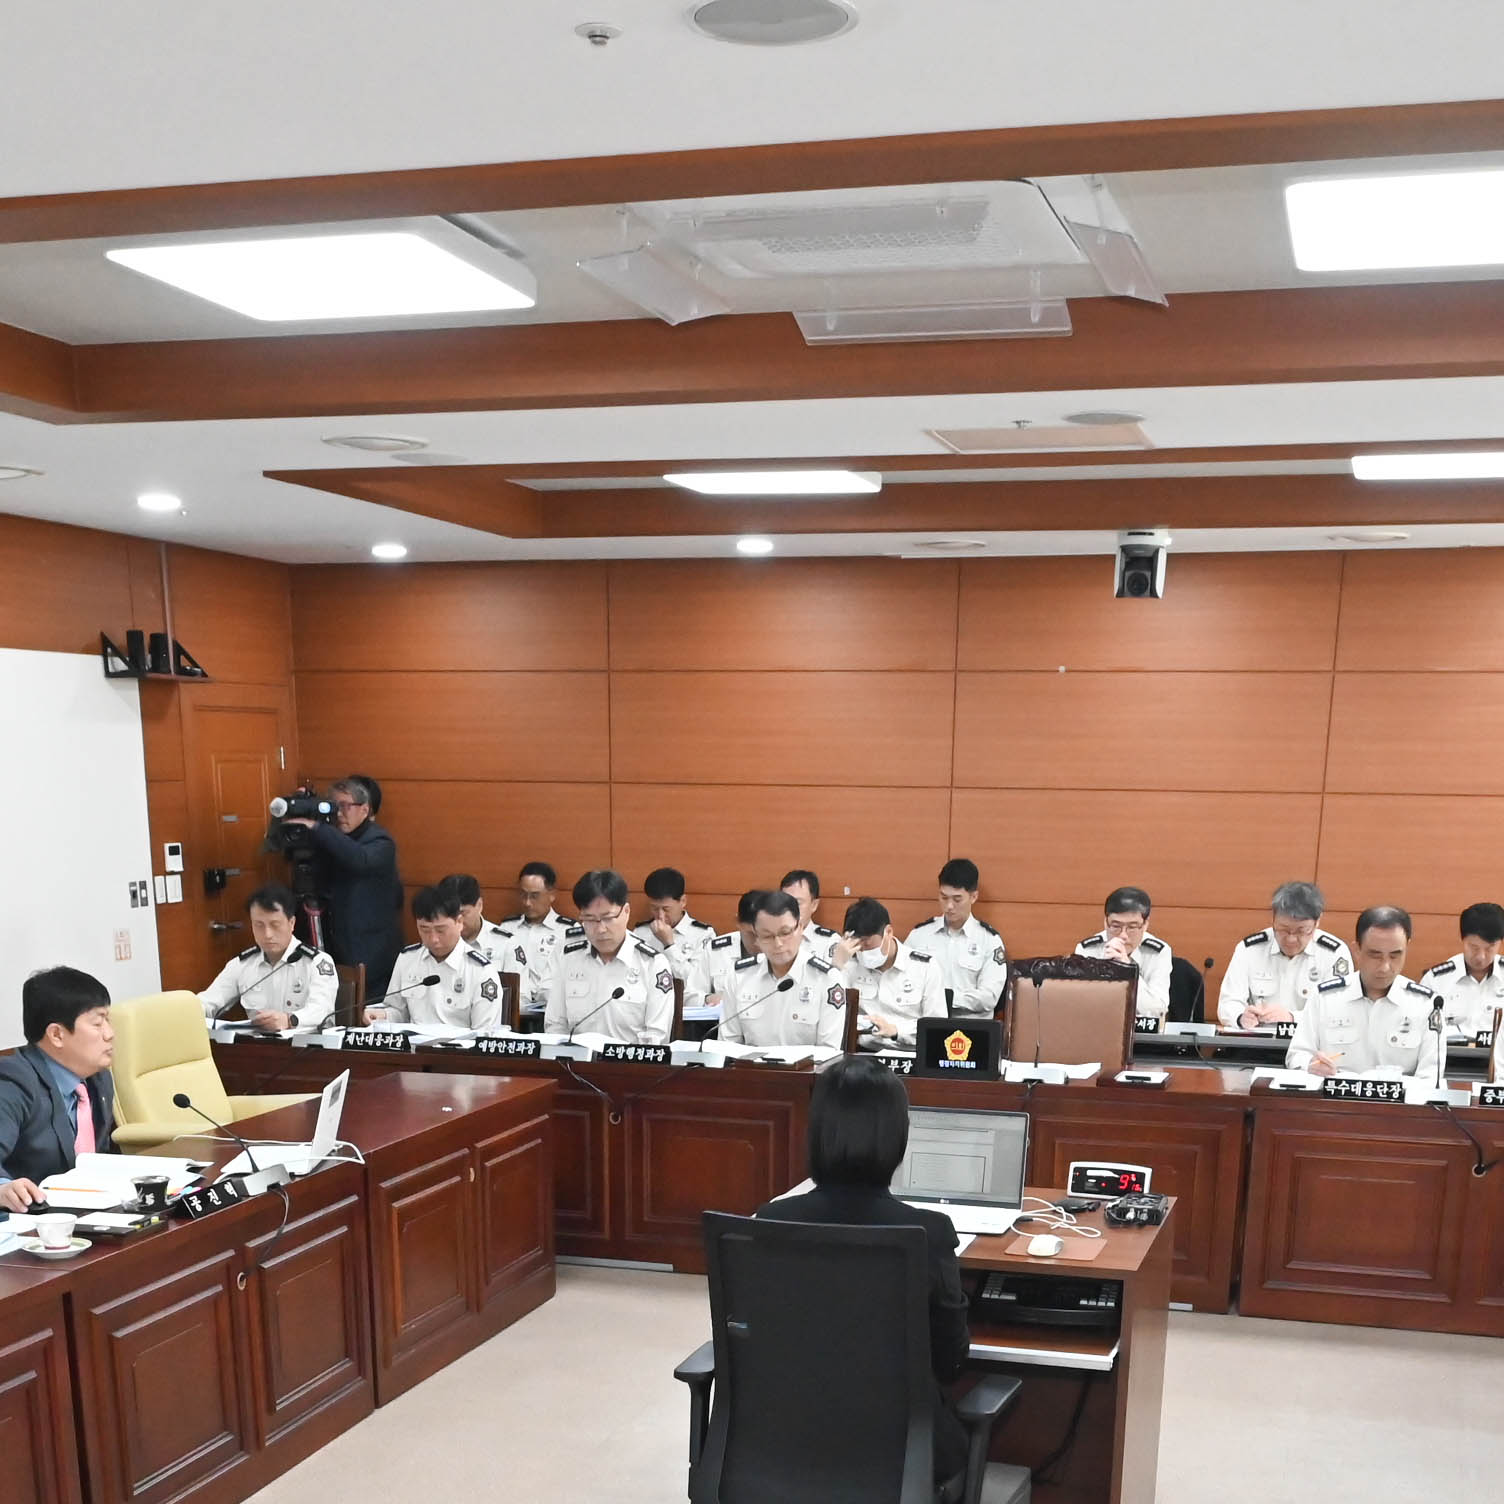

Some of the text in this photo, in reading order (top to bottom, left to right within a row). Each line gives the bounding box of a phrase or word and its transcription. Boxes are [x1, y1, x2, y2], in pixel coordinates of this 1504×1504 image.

[1135, 1018, 1157, 1031] 서장
[345, 1032, 404, 1049] 재난대응과장
[479, 1040, 536, 1055] 예방안전과장
[605, 1046, 666, 1062] 소방행정과장
[1324, 1080, 1404, 1099] 특수대응단장
